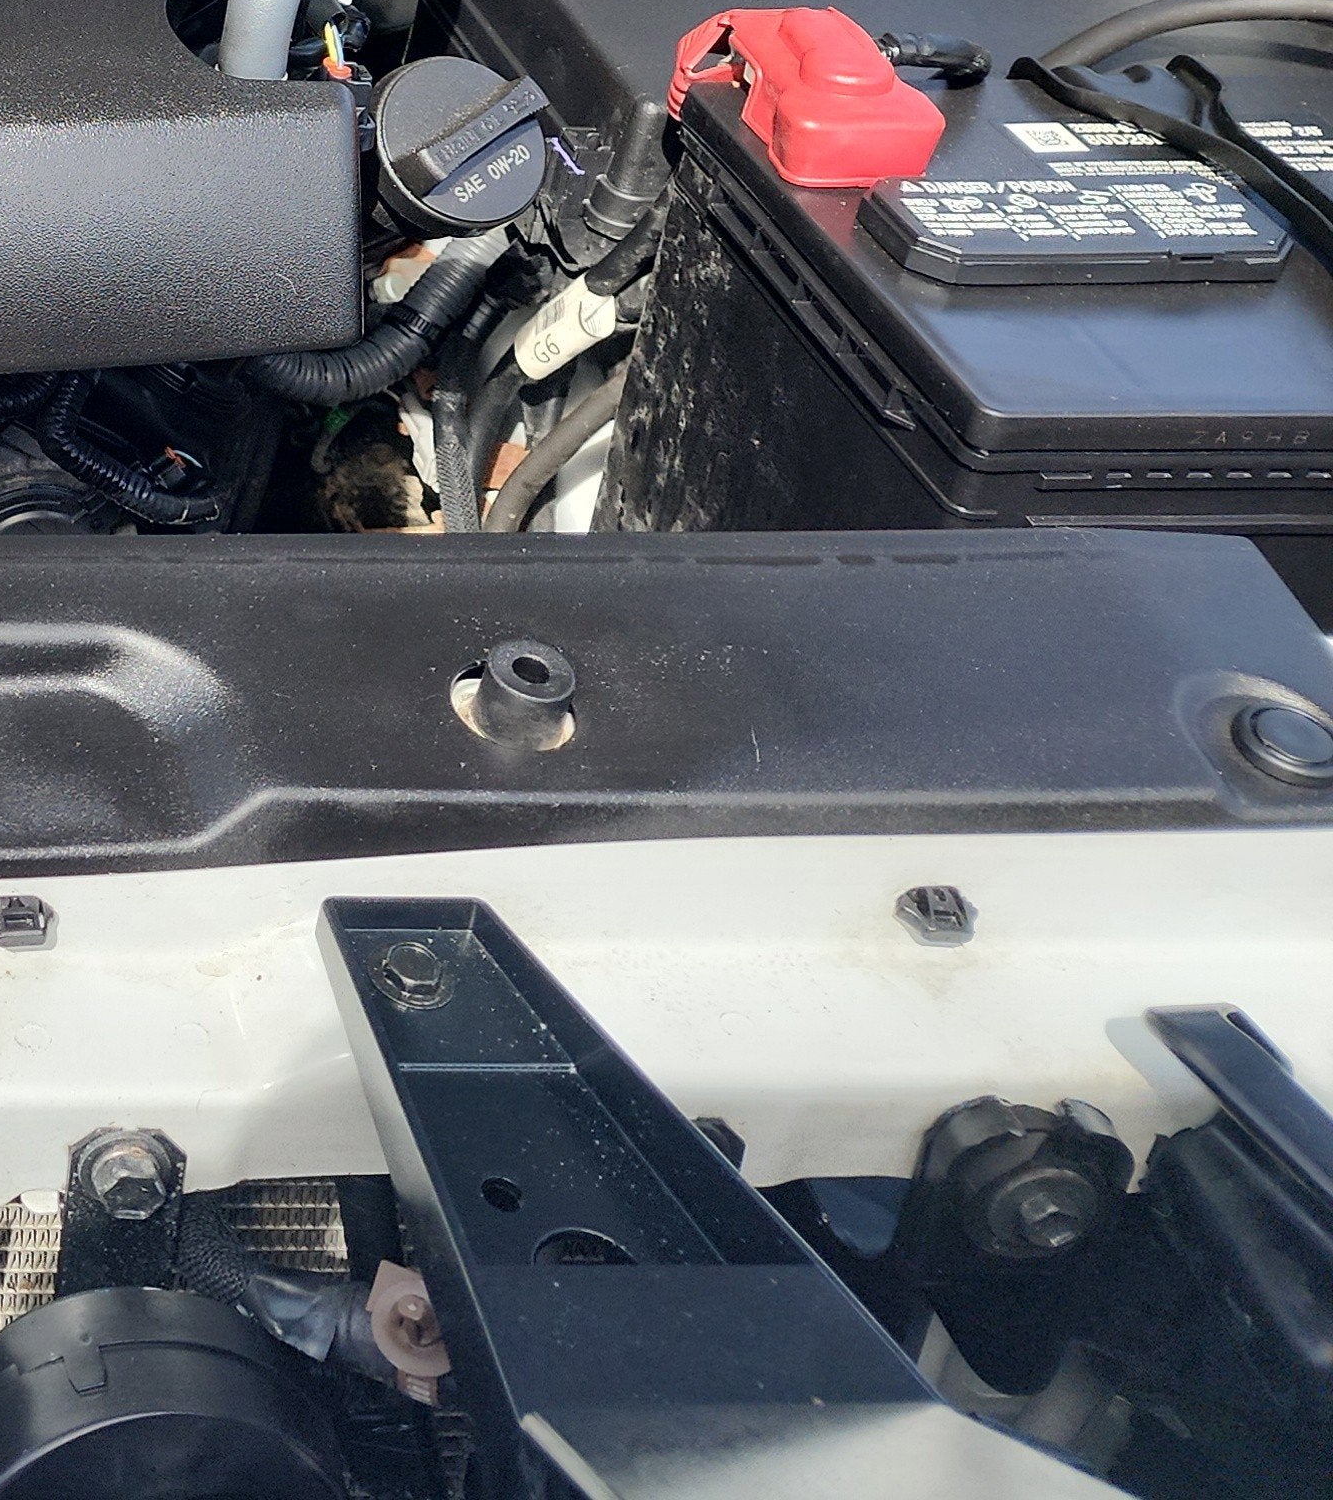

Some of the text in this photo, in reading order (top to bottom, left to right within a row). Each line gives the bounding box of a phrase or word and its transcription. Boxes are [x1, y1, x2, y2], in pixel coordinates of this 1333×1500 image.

[453, 143, 532, 204] SAE 0W-20
[531, 333, 562, 364] G6
